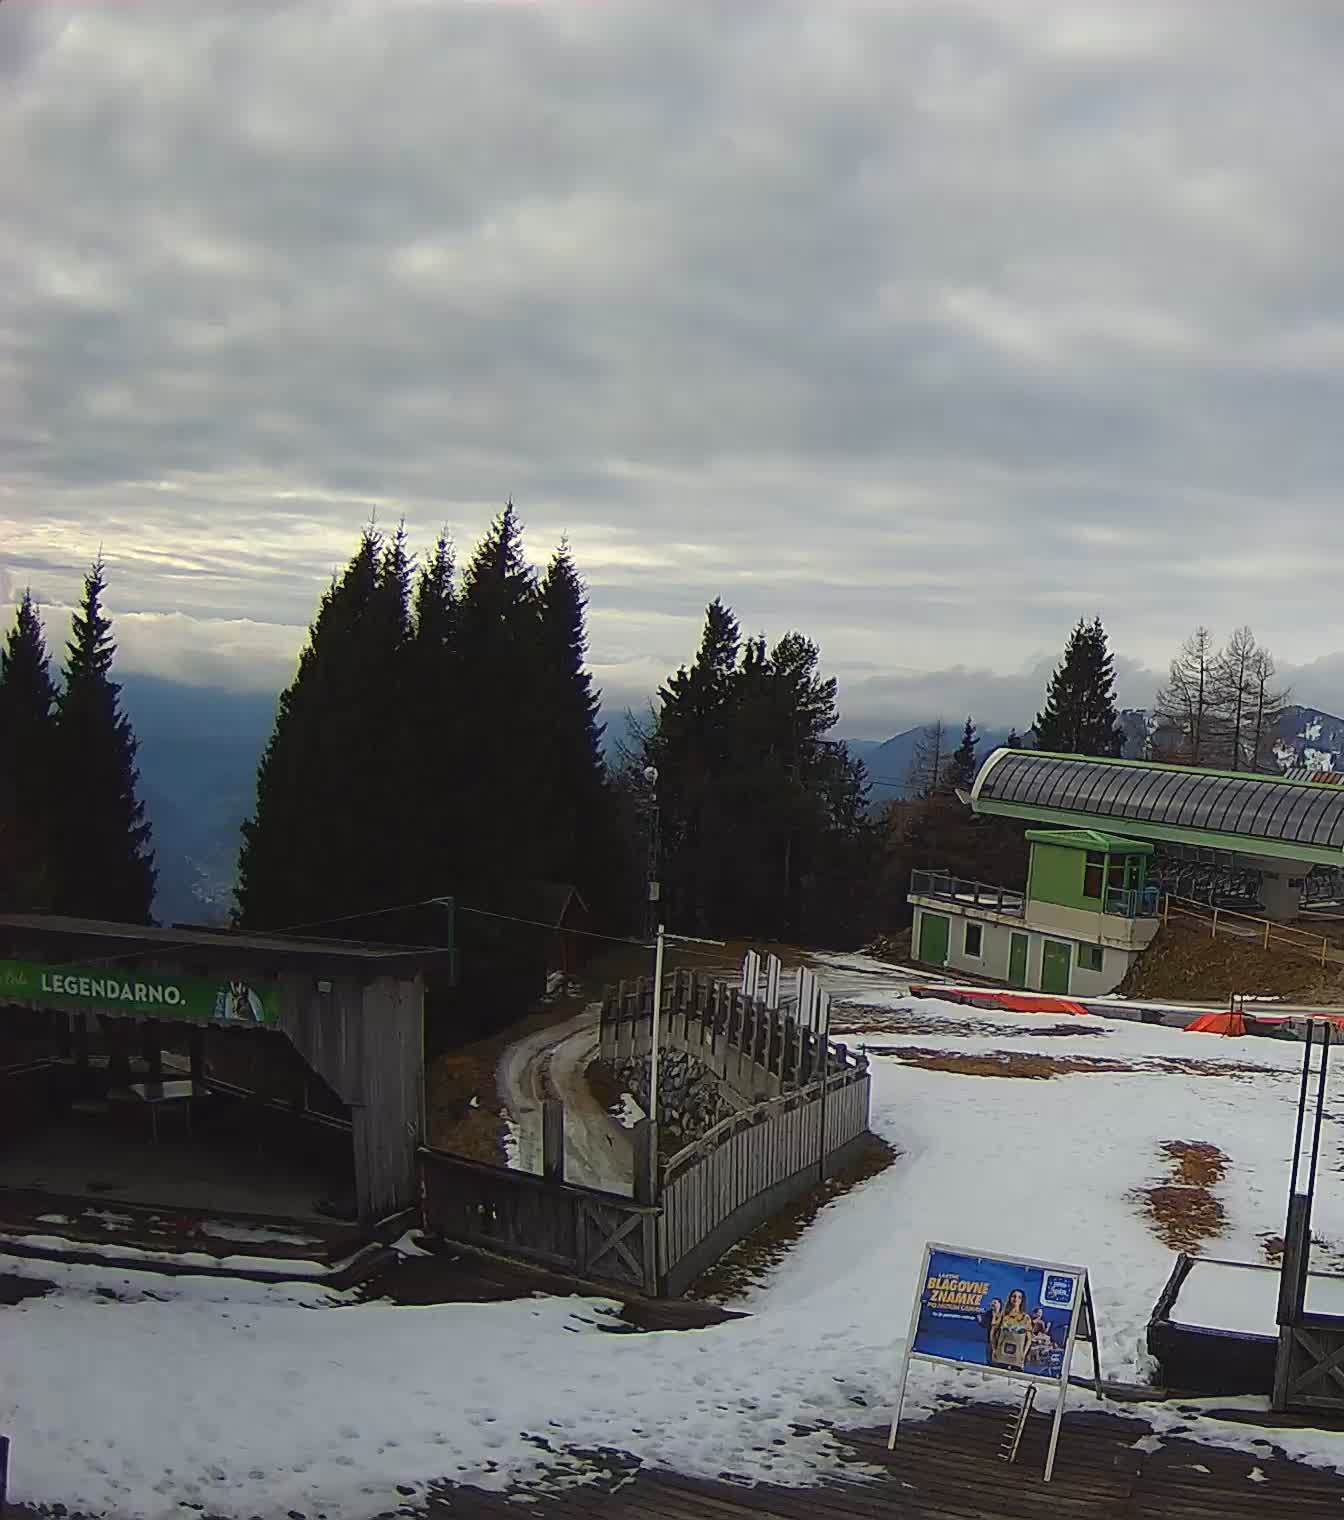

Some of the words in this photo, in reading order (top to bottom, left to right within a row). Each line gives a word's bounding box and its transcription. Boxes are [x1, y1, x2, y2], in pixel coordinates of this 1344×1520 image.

[41, 973, 187, 1005] LEGENDARNO.
[927, 1277, 990, 1294] BLAGOVNE
[929, 1290, 983, 1306] ZNAMKE
